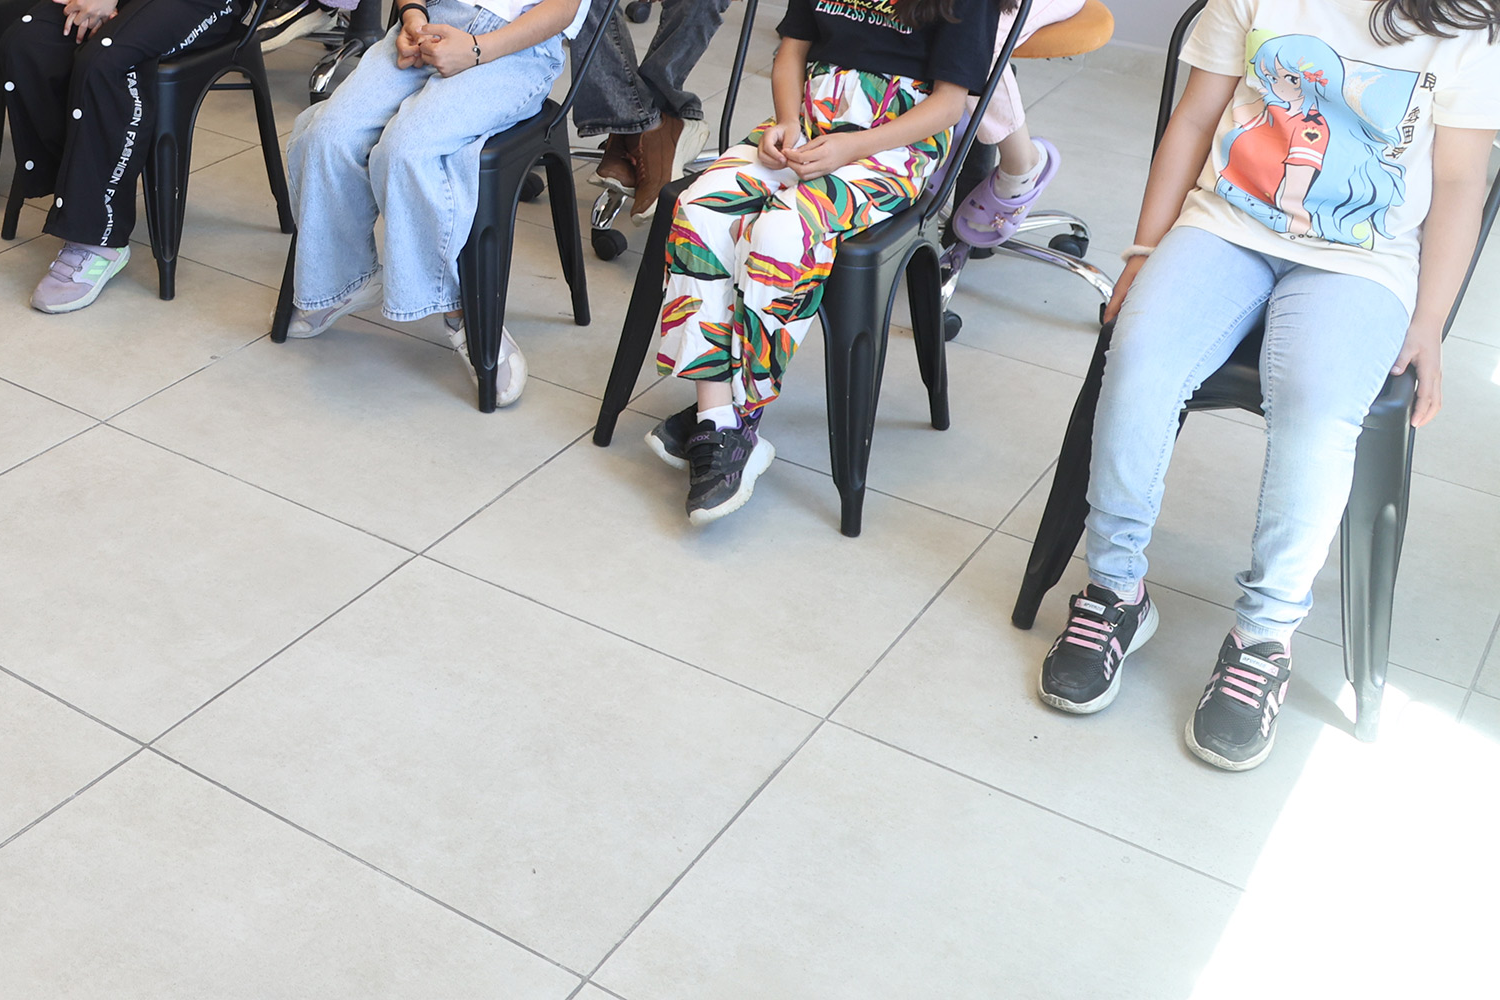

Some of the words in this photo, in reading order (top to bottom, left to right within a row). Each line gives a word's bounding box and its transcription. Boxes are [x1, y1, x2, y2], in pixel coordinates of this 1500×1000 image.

[179, 11, 218, 50] FASHION
[126, 71, 143, 127] FASHION
[109, 130, 137, 185] FASHION
[100, 188, 116, 247] FASHION
